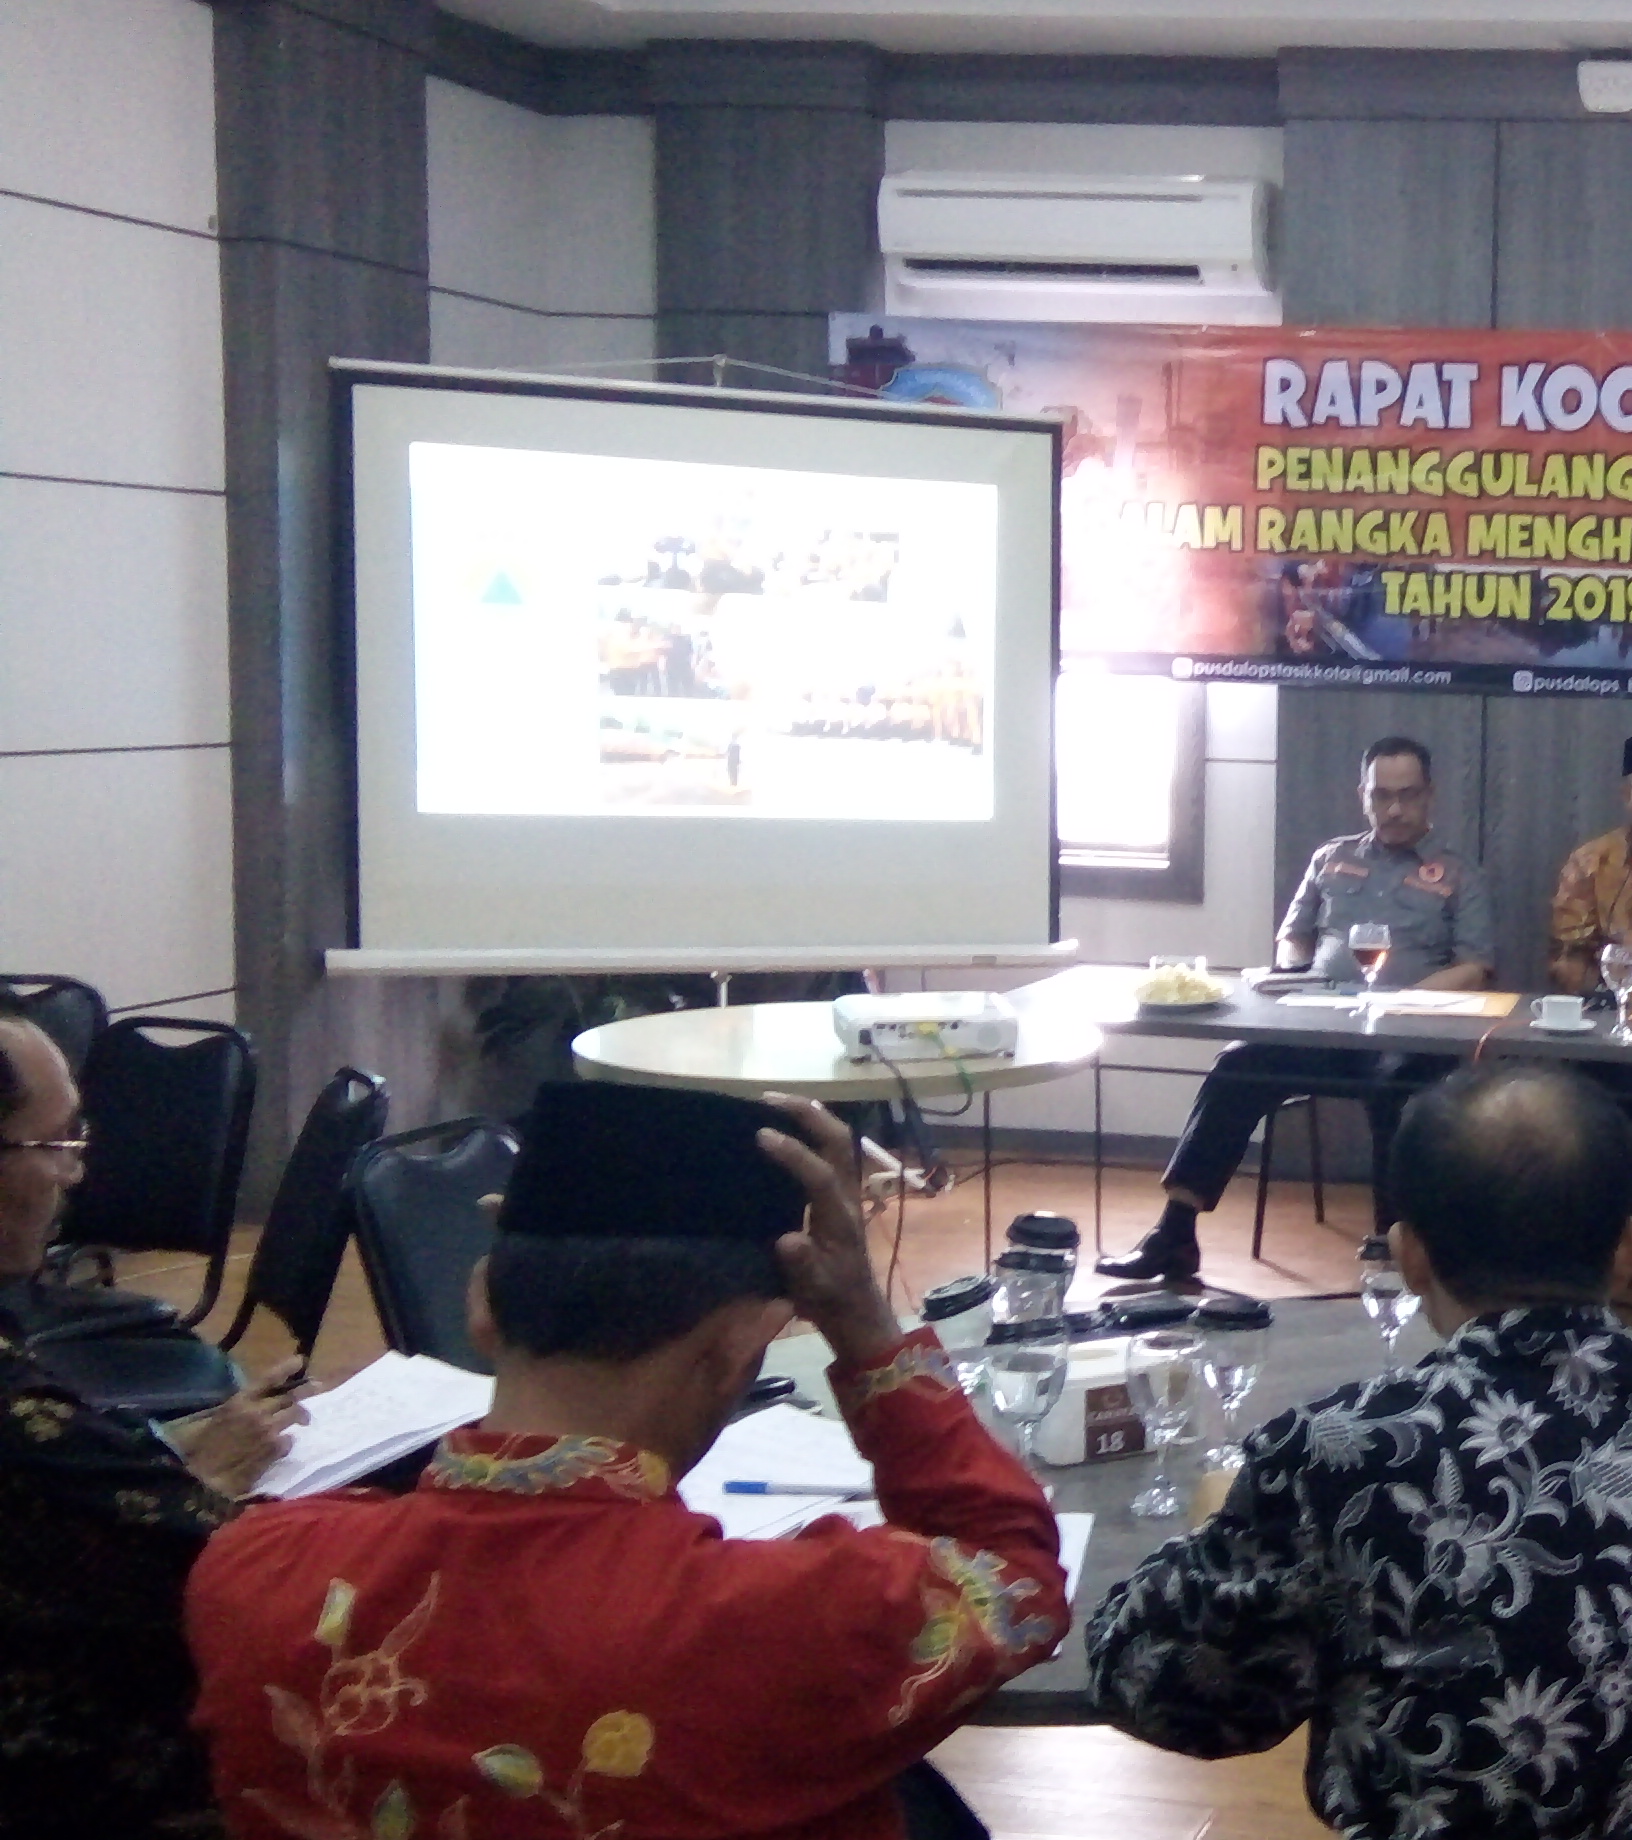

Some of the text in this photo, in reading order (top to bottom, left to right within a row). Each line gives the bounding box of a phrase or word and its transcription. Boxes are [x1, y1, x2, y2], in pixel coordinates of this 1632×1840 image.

[1263, 358, 1479, 429] RAPAT
[1257, 506, 1453, 557] RANGKA
[1382, 570, 1532, 621] TAHUN
[1096, 1430, 1125, 1455] 18
